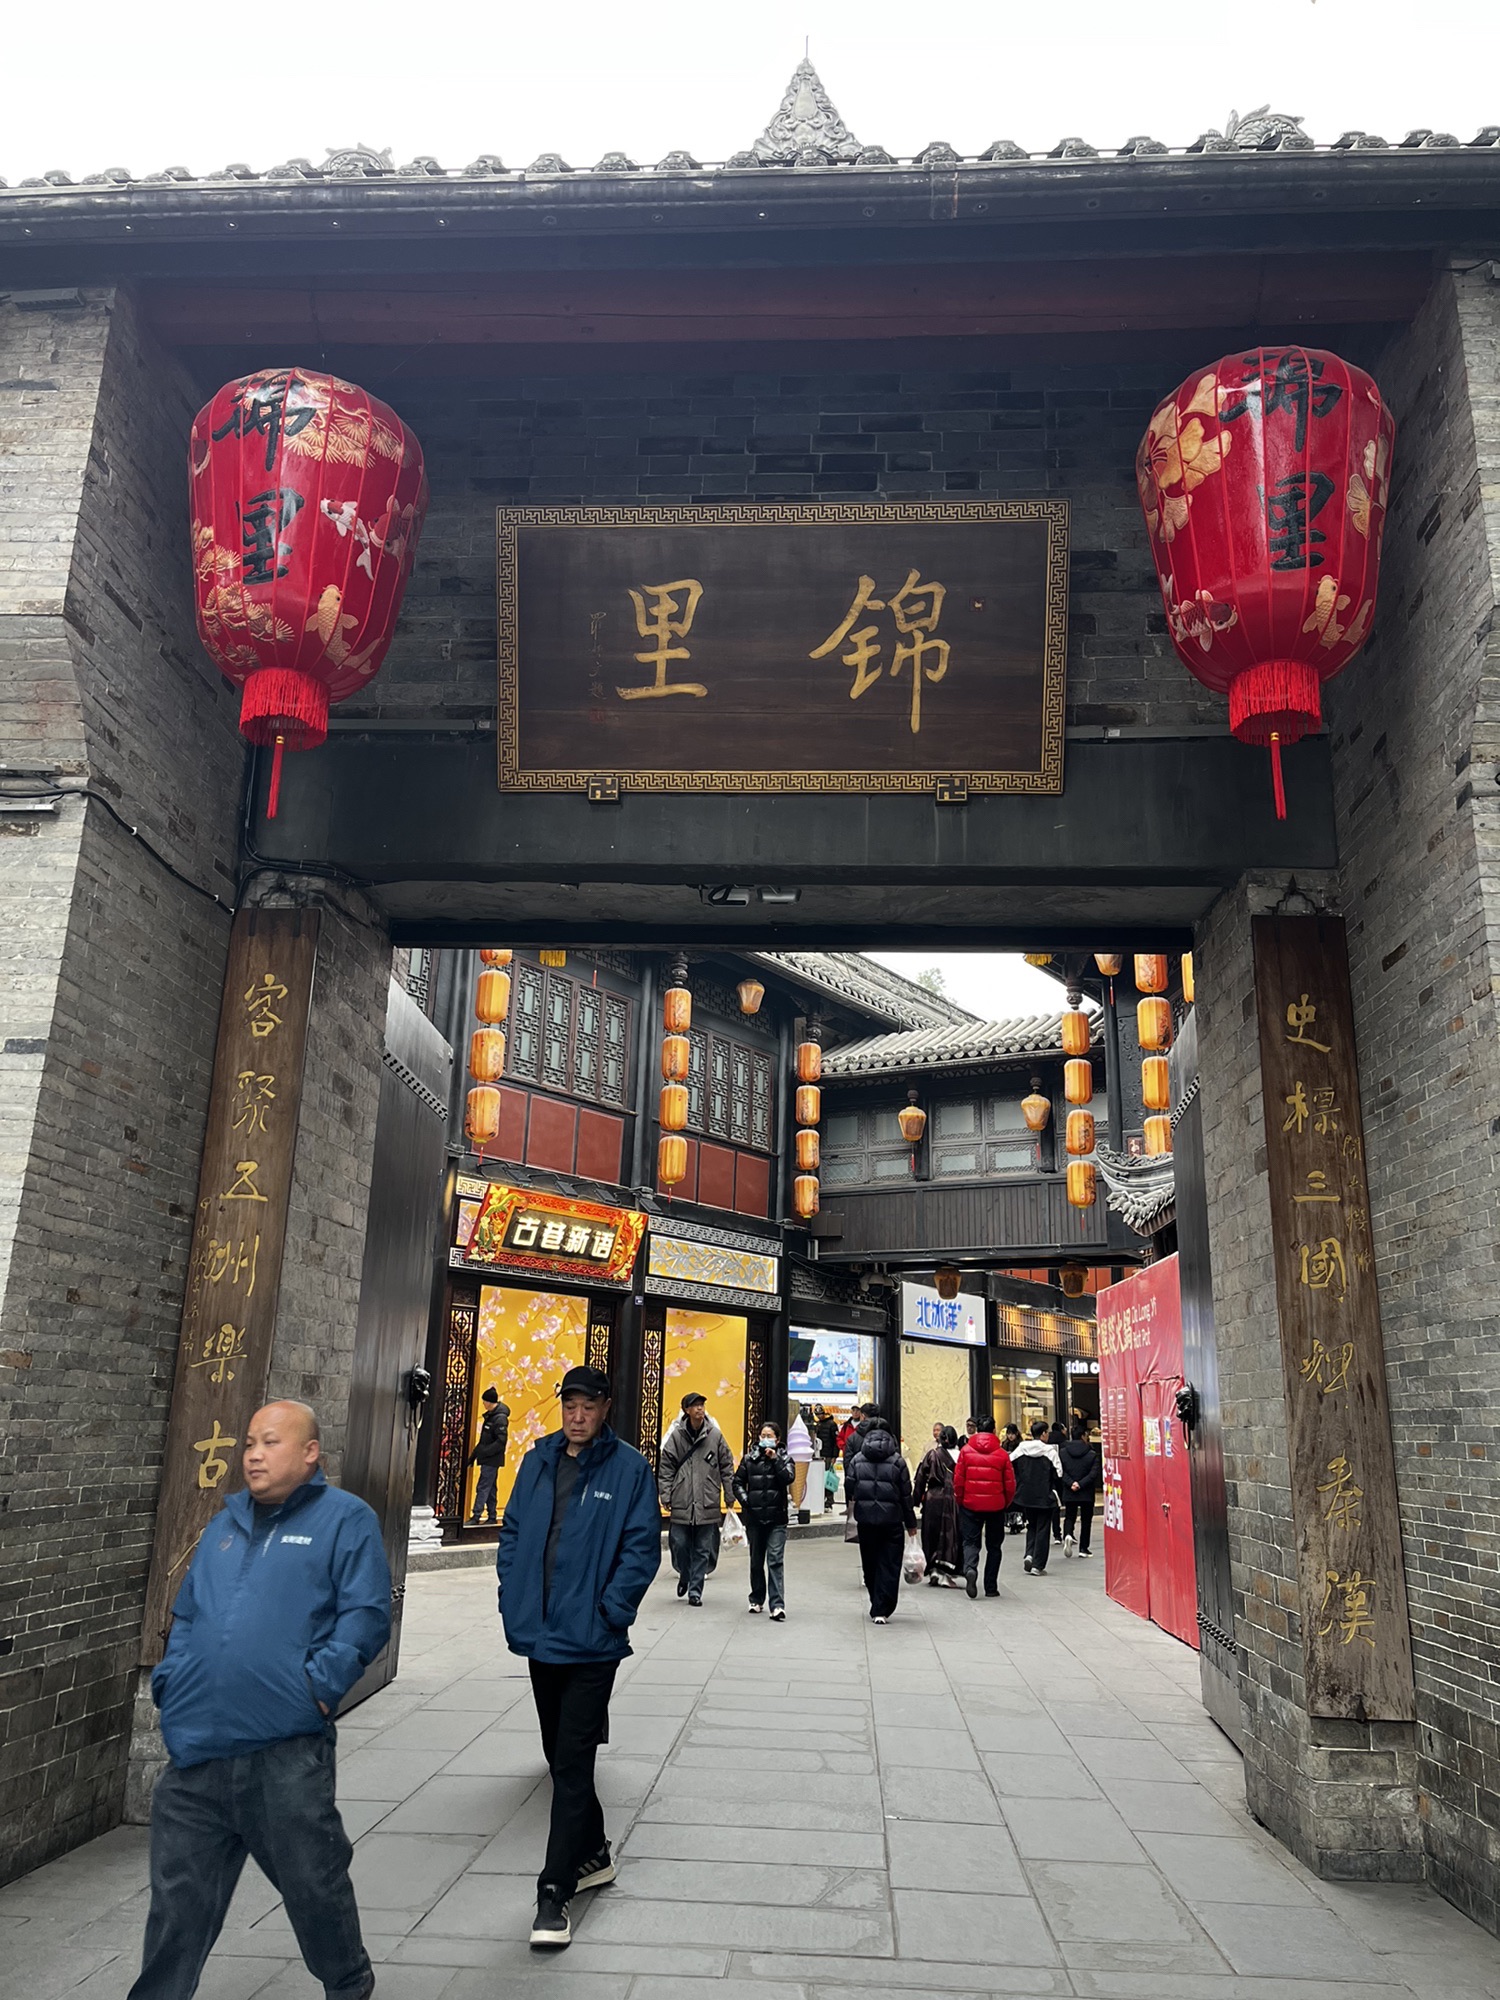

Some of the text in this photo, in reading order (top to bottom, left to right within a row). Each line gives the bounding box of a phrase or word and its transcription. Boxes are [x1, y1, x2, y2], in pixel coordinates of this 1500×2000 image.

[512, 1215, 616, 1260] 古巷新语
[167, 973, 289, 1577] 客聚五洲樂古
[915, 1296, 958, 1332] 北冰洋
